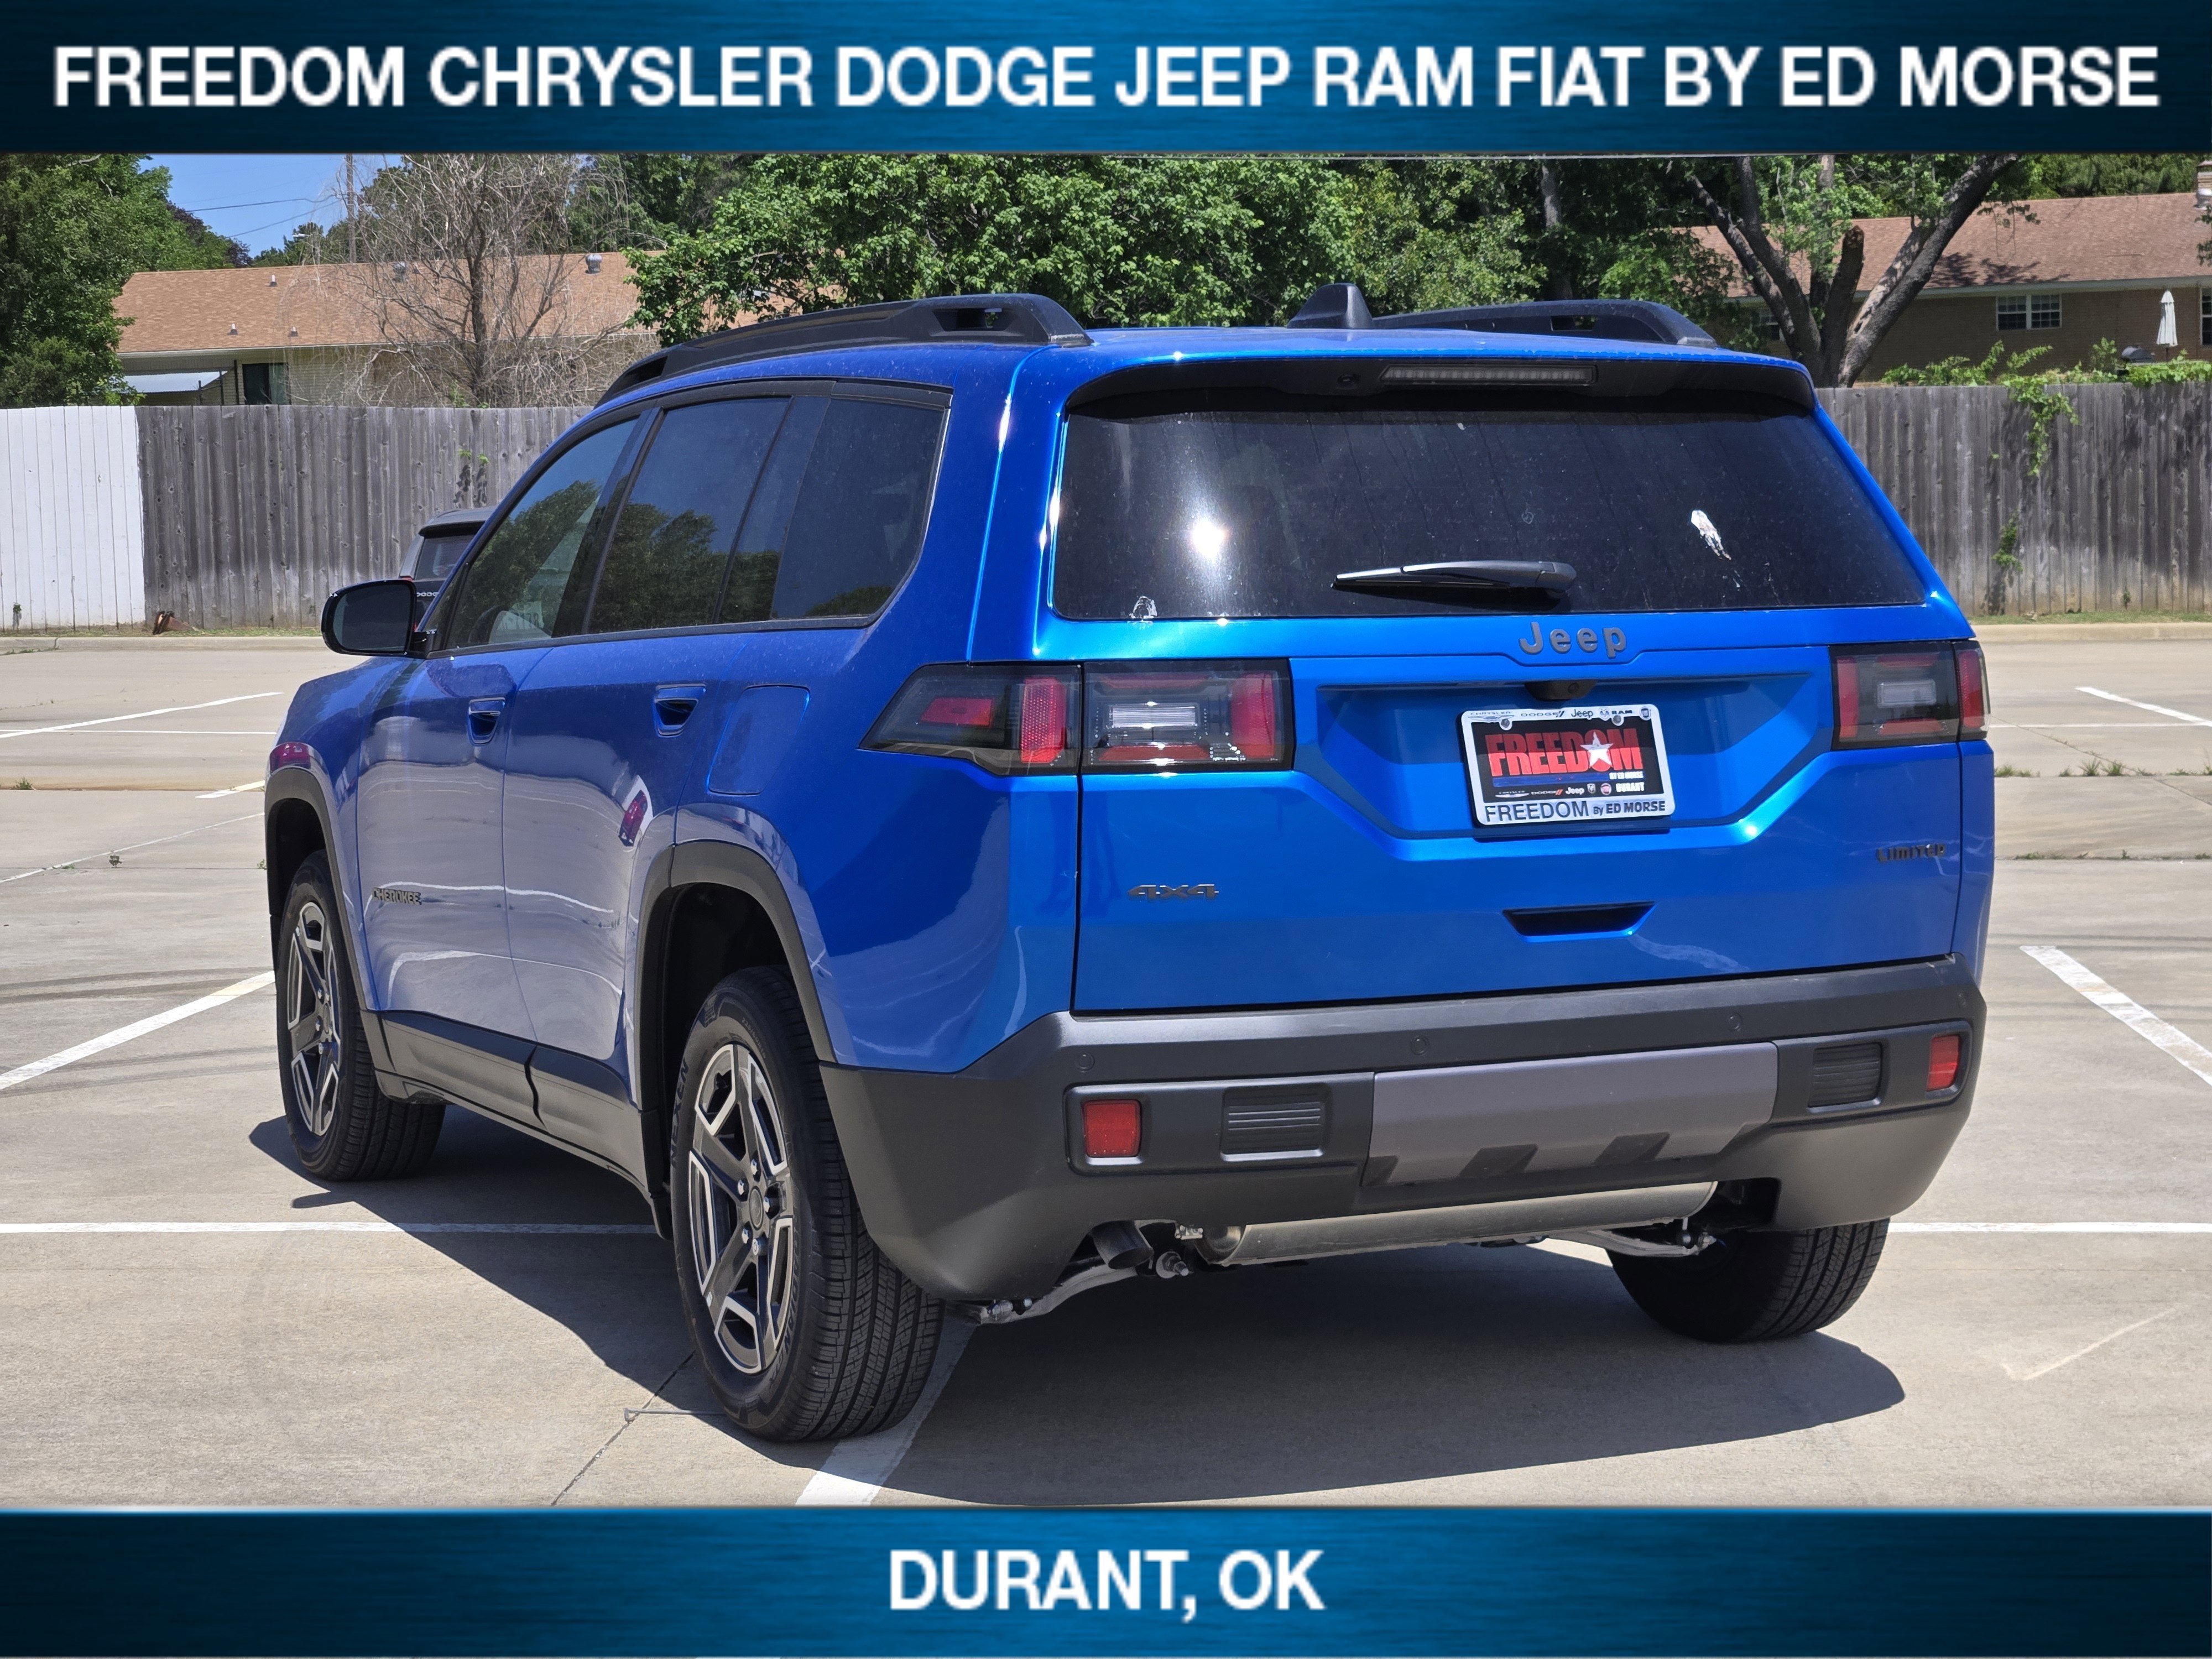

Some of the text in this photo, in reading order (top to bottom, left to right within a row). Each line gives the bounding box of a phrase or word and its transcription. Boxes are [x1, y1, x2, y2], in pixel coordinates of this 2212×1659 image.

[1518, 621, 1627, 659] Jeep
[1571, 709, 1594, 718] Jeep
[1485, 728, 1644, 777] FREEDOM
[1565, 786, 1585, 795] Jeep
[1485, 801, 1589, 822] FREEDOM
[1606, 803, 1621, 813] ED
[1624, 801, 1666, 813] MORSE
[1877, 843, 1945, 862] LIMITED
[372, 887, 421, 905] CHEROKEE
[671, 1056, 689, 1169] NEXEN
